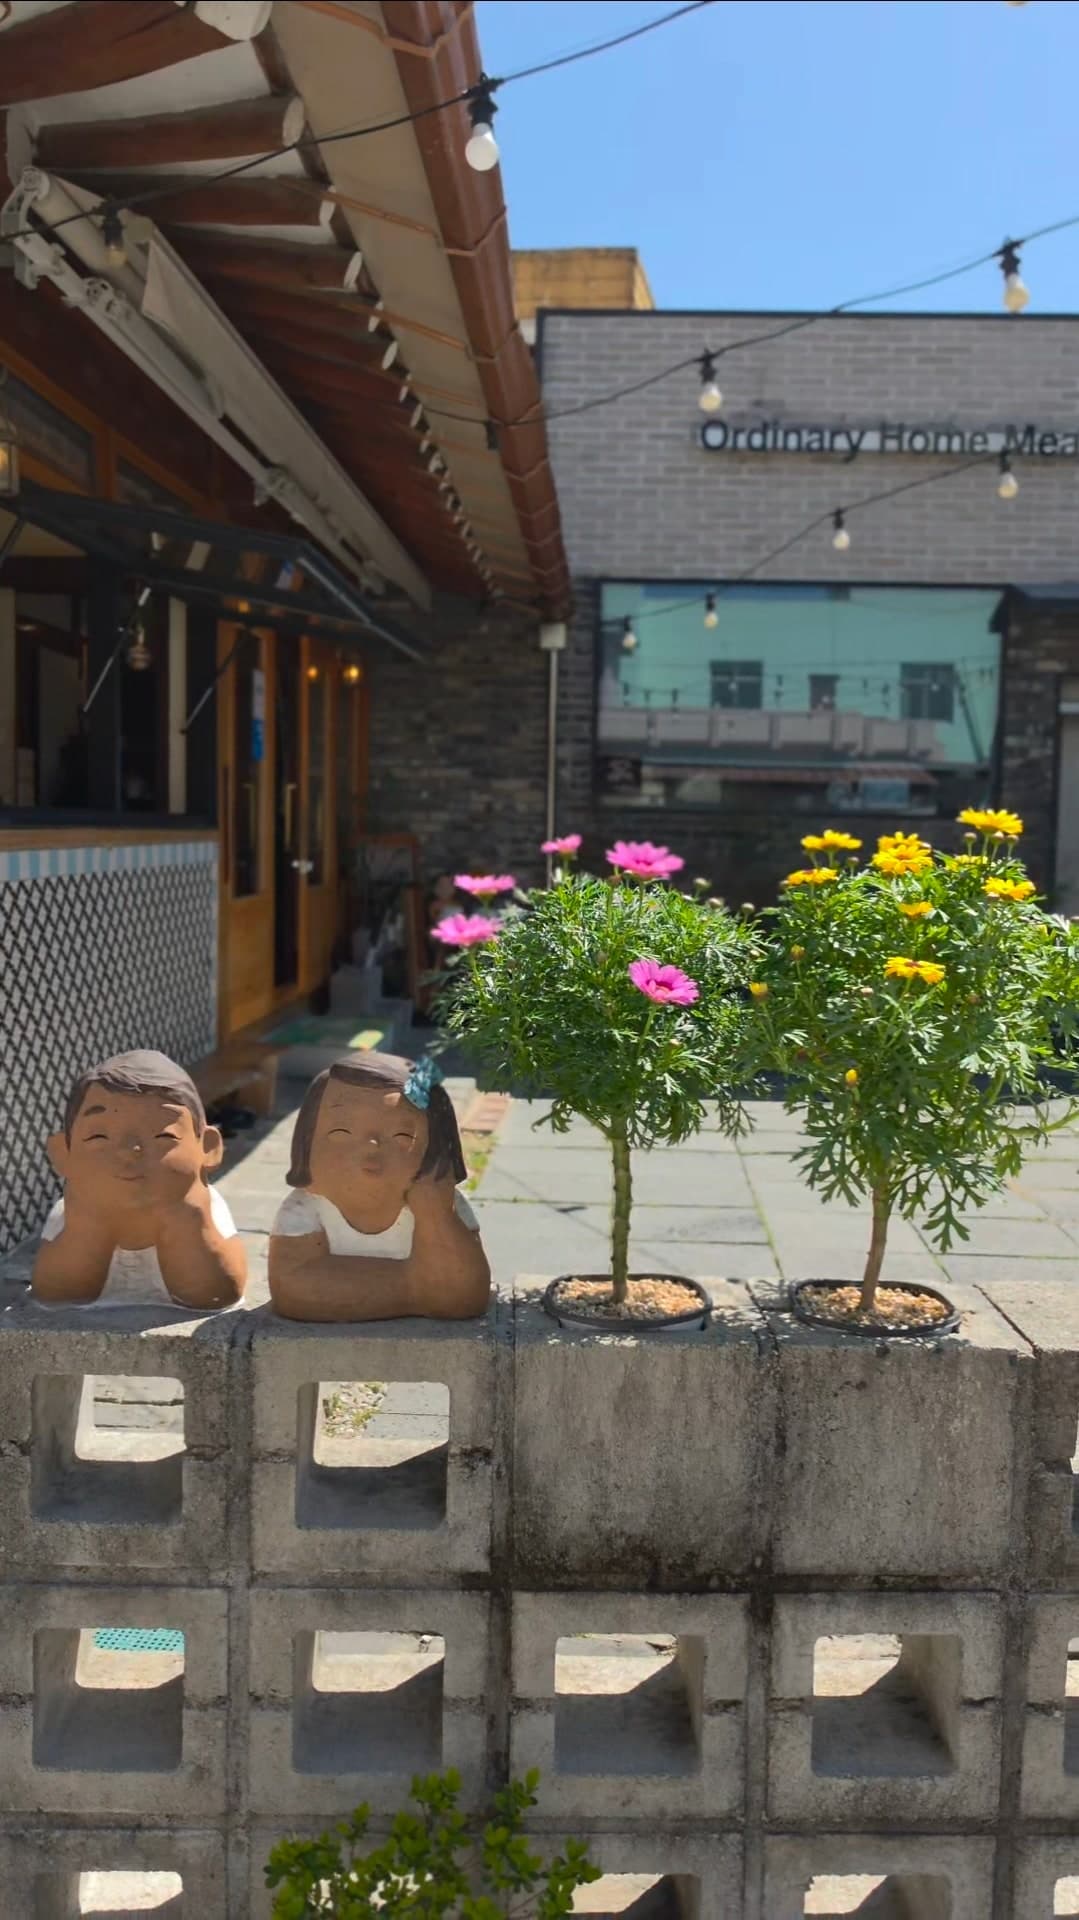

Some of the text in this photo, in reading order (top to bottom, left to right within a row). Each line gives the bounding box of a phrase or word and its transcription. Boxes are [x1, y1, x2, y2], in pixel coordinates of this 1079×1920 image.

[702, 420, 1079, 463] Ordinary Home Mea
